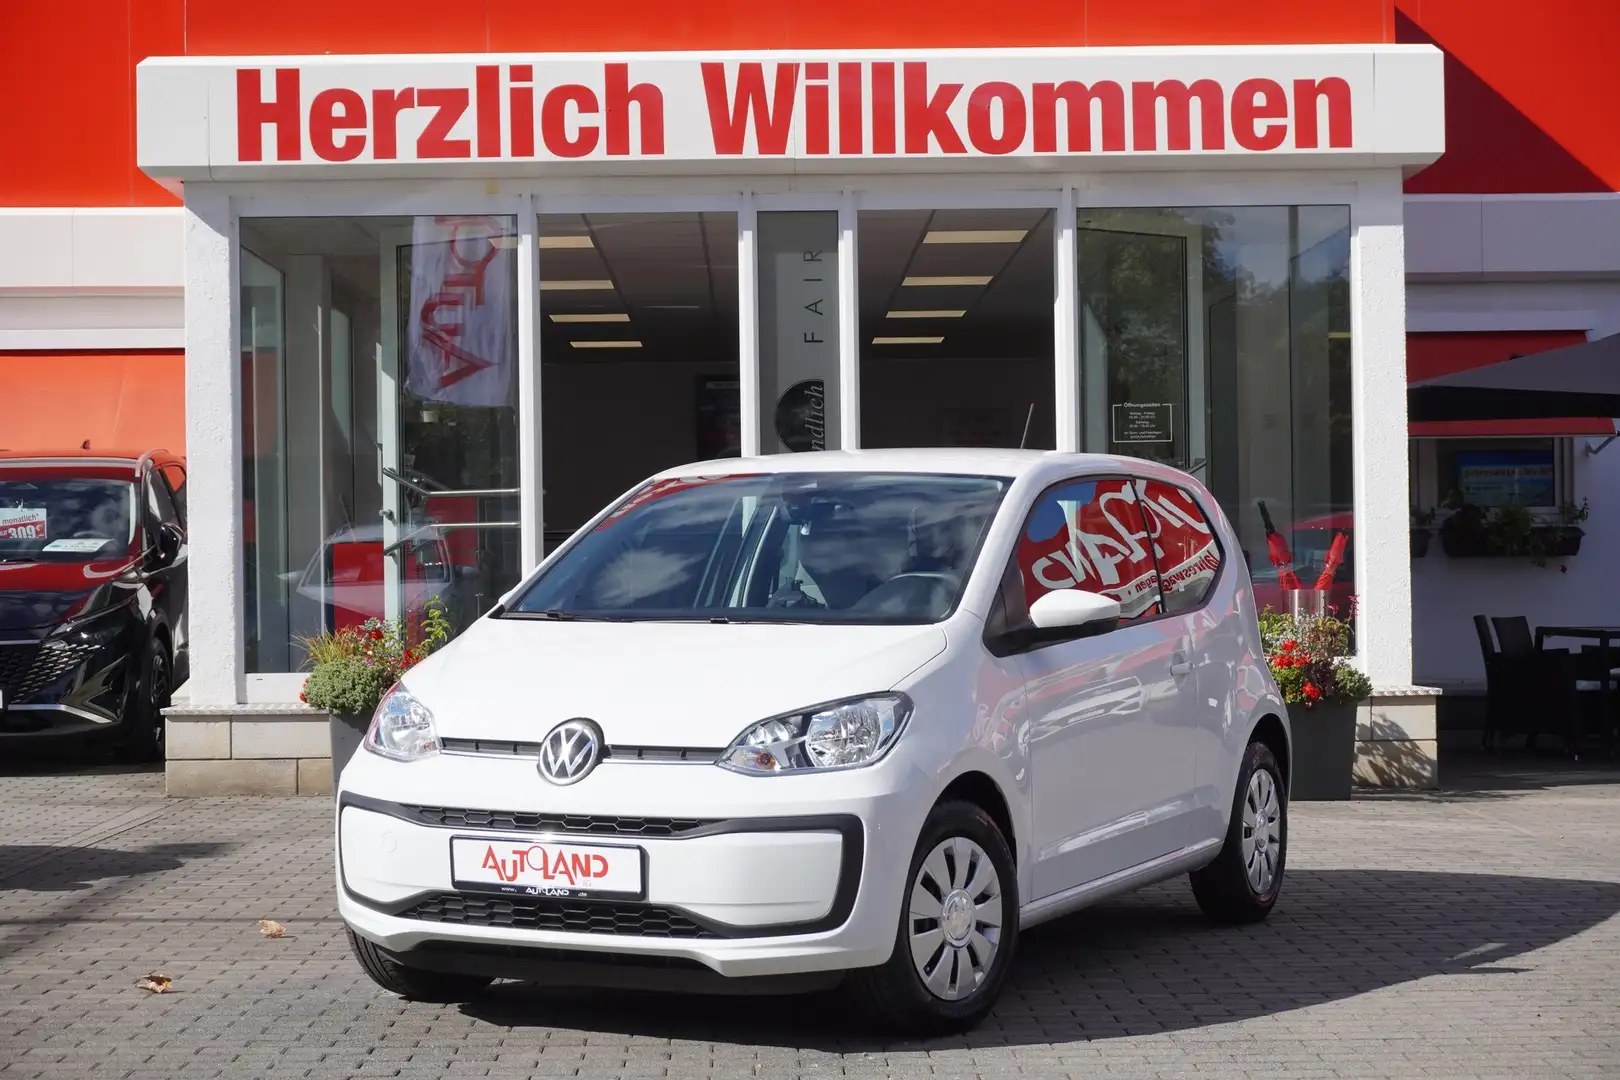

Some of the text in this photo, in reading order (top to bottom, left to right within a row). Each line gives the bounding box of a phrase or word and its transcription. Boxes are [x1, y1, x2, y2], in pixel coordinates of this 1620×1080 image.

[237, 62, 1352, 162] Herzlich Willkommen
[803, 249, 824, 343] FAIR
[481, 845, 609, 885] AUTOLAND
[525, 887, 570, 897] AUTOLAND
